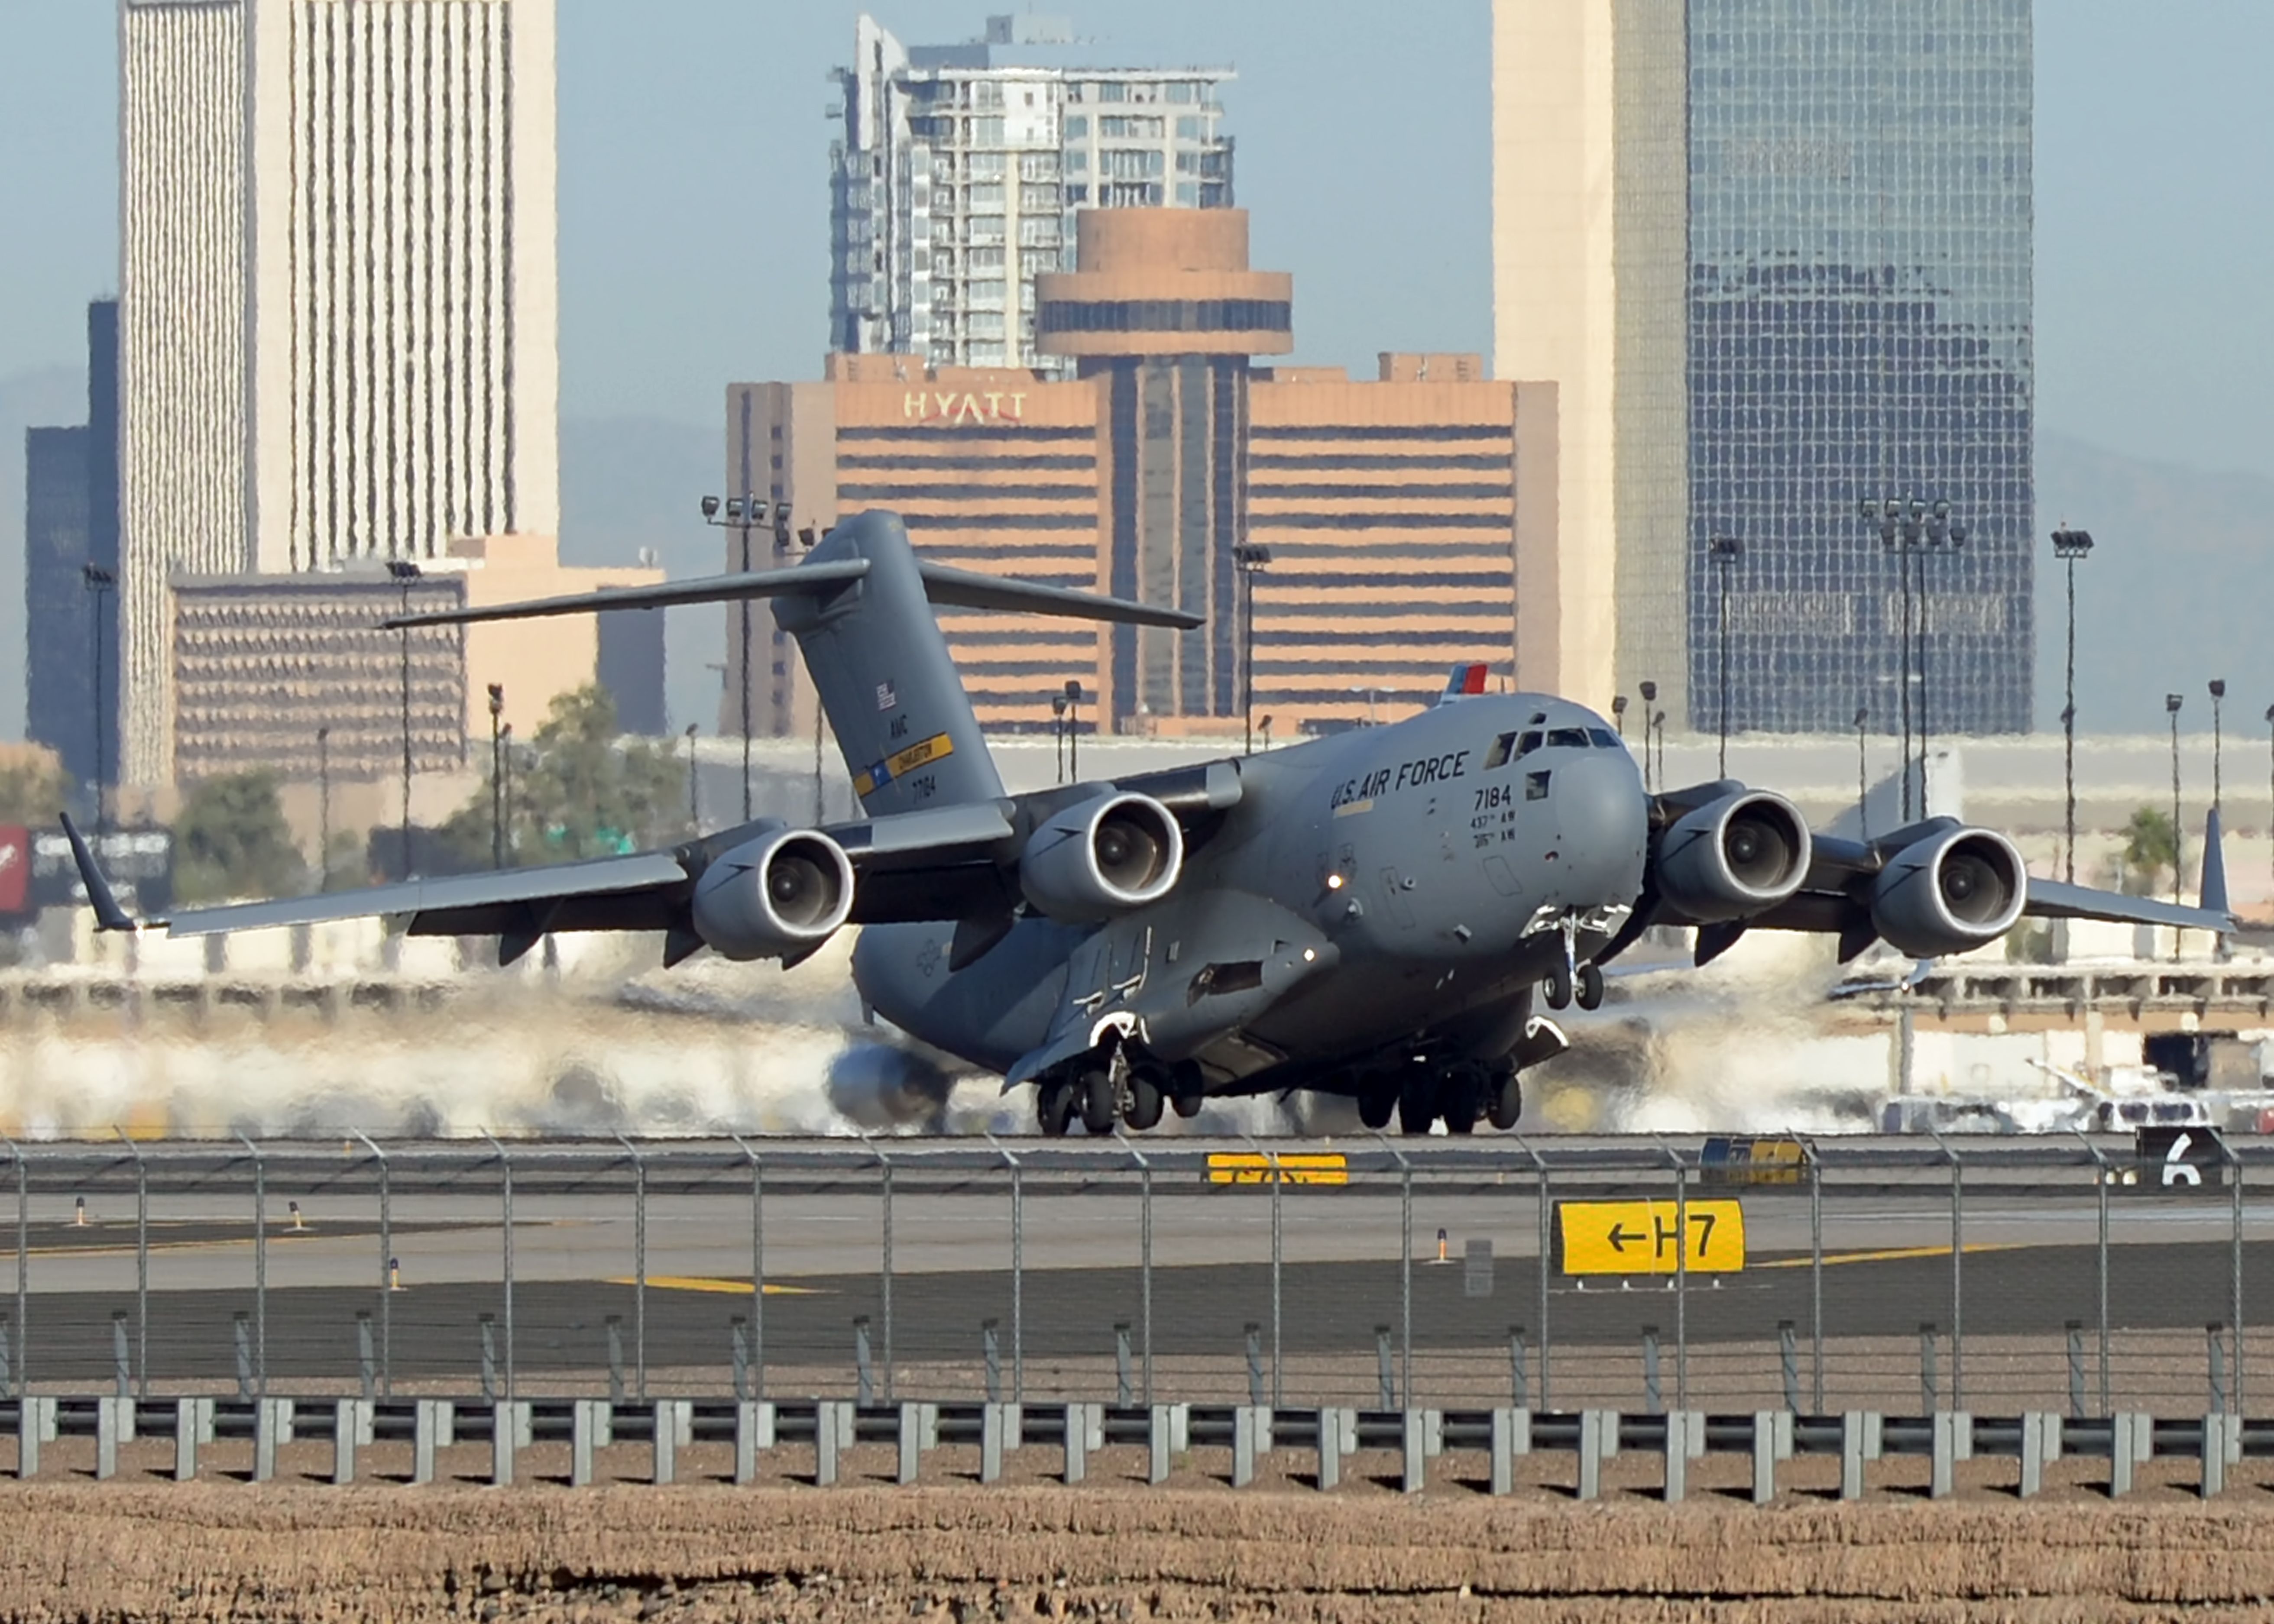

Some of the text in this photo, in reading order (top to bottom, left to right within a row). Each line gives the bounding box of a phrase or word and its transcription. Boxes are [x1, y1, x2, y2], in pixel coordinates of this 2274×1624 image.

[904, 391, 1027, 424] HYATT
[1358, 768, 1391, 801] AIR
[1395, 750, 1470, 791] FORCE
[1475, 784, 1511, 811] 7184
[1655, 1215, 1716, 1258] H7
